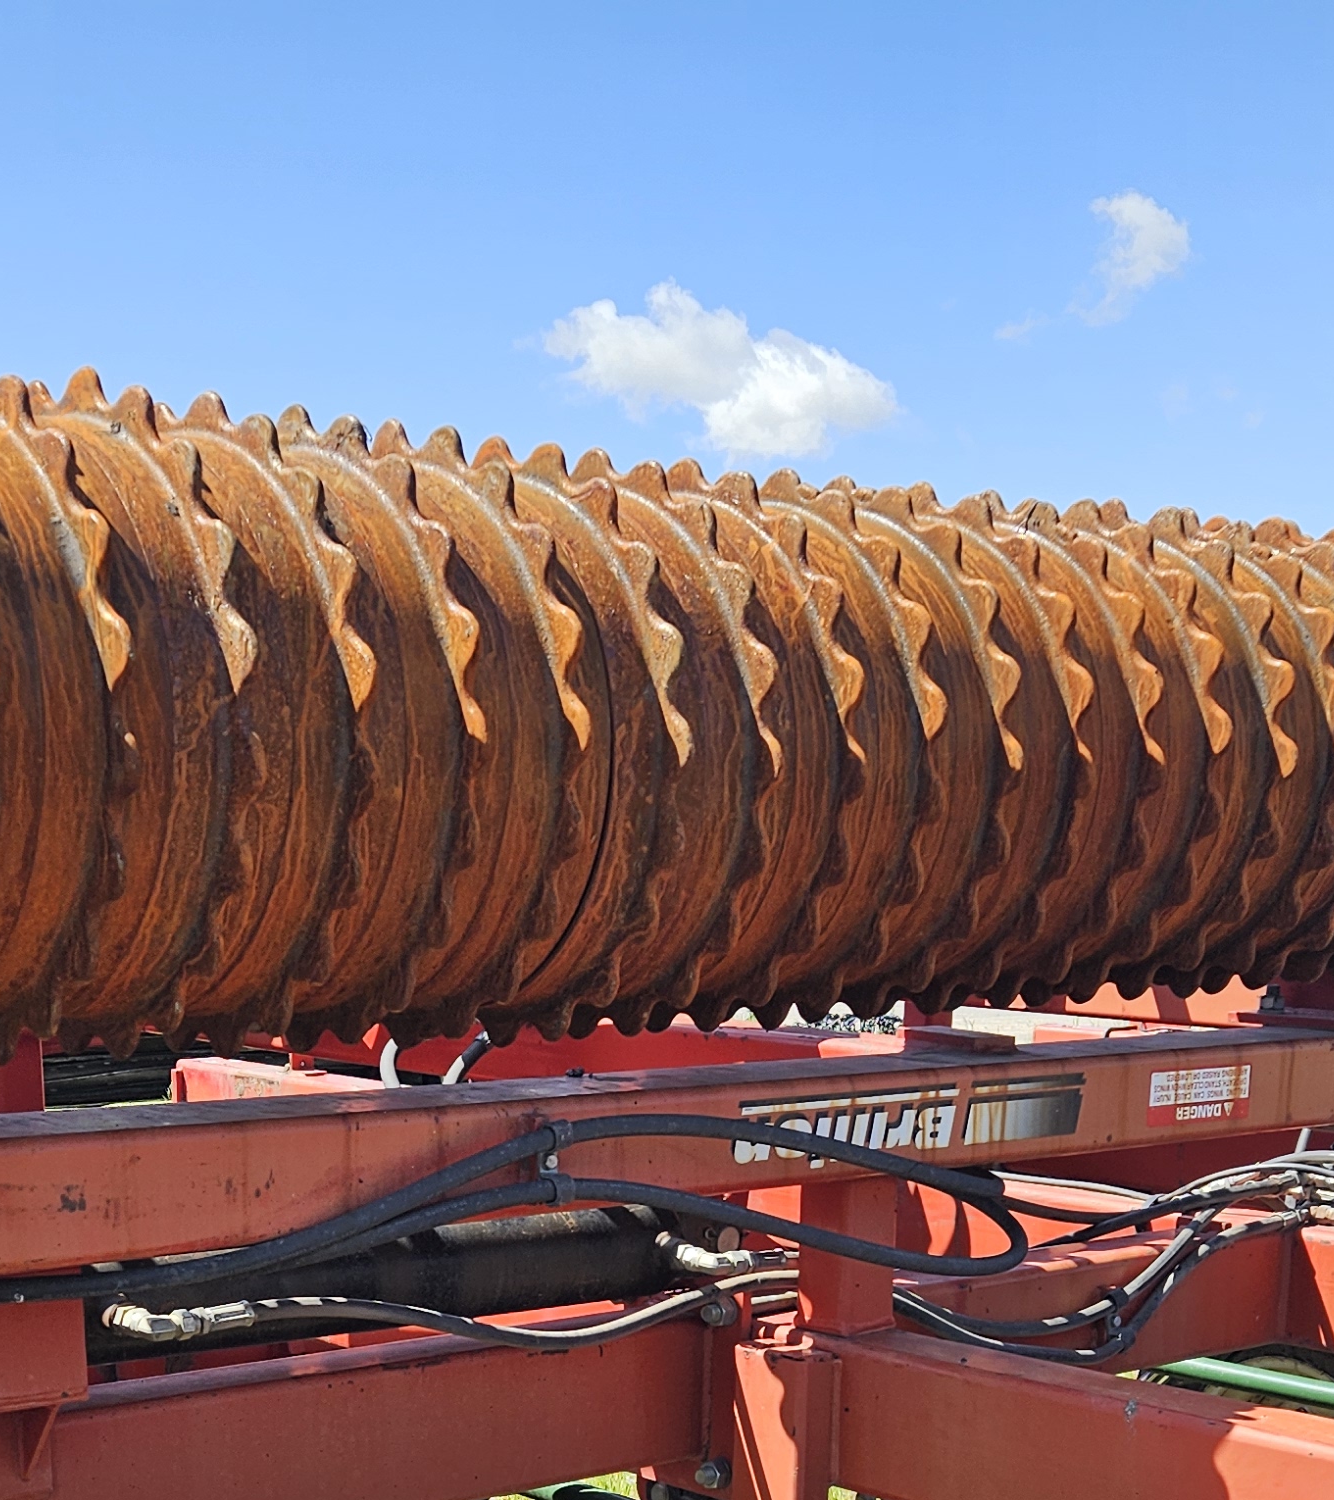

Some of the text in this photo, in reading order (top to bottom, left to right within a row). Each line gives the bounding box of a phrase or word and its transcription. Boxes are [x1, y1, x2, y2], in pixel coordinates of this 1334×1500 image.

[1193, 1090, 1204, 1099] CAN
[1206, 1088, 1223, 1098] WINGS
[1175, 1102, 1222, 1120] DANGER
